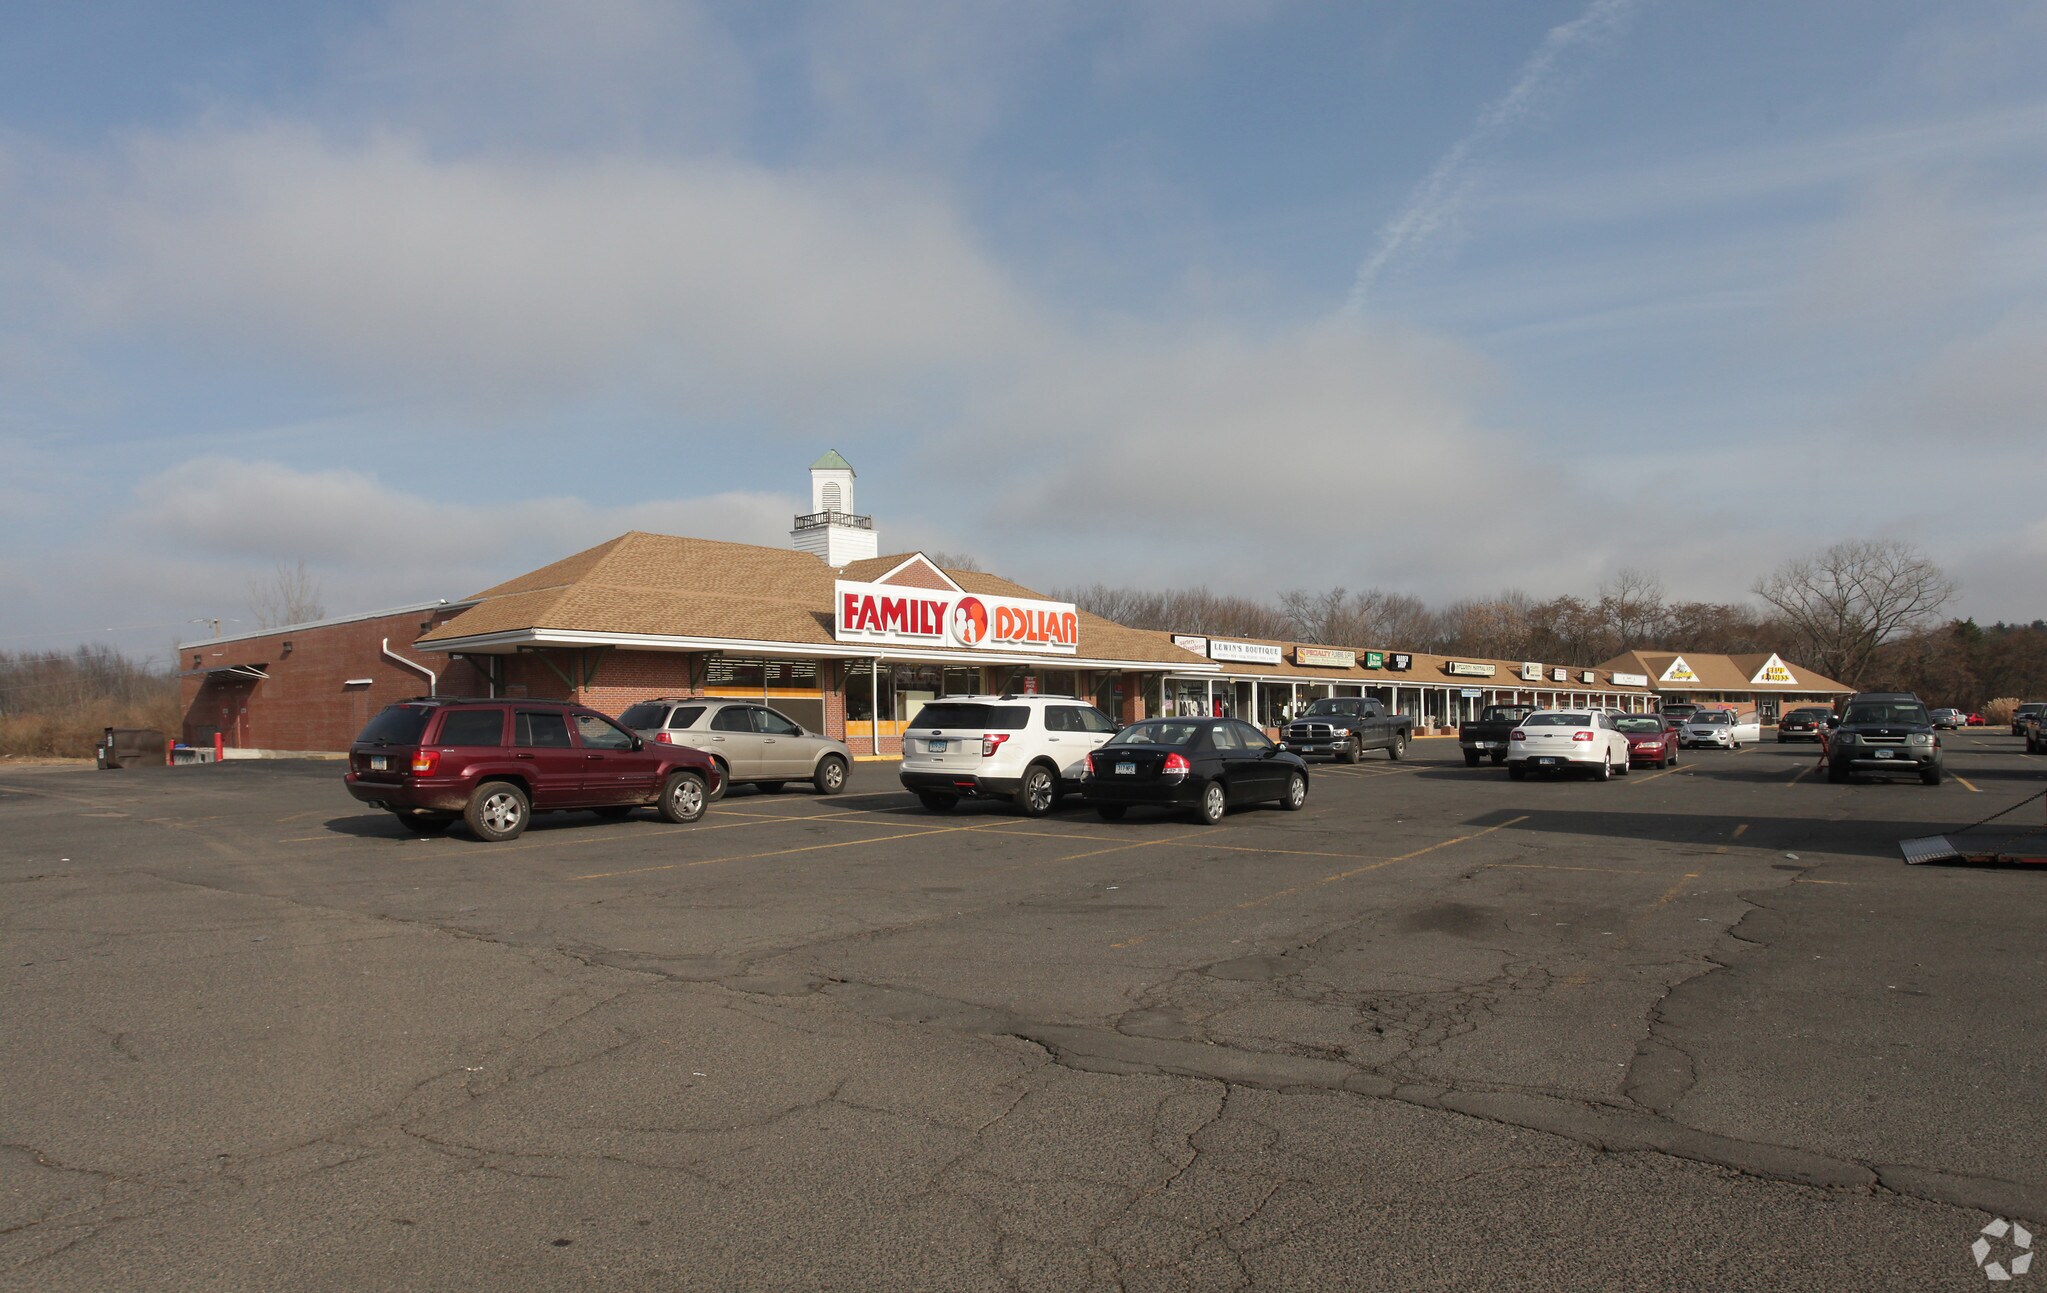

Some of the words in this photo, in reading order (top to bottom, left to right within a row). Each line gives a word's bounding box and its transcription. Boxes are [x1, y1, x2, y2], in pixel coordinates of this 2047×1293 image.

[843, 593, 948, 635] FAMILY
[995, 605, 1077, 644] DOLLAR
[1214, 644, 1241, 652] LEWIN'S
[1246, 646, 1278, 654] BOUTIQUE
